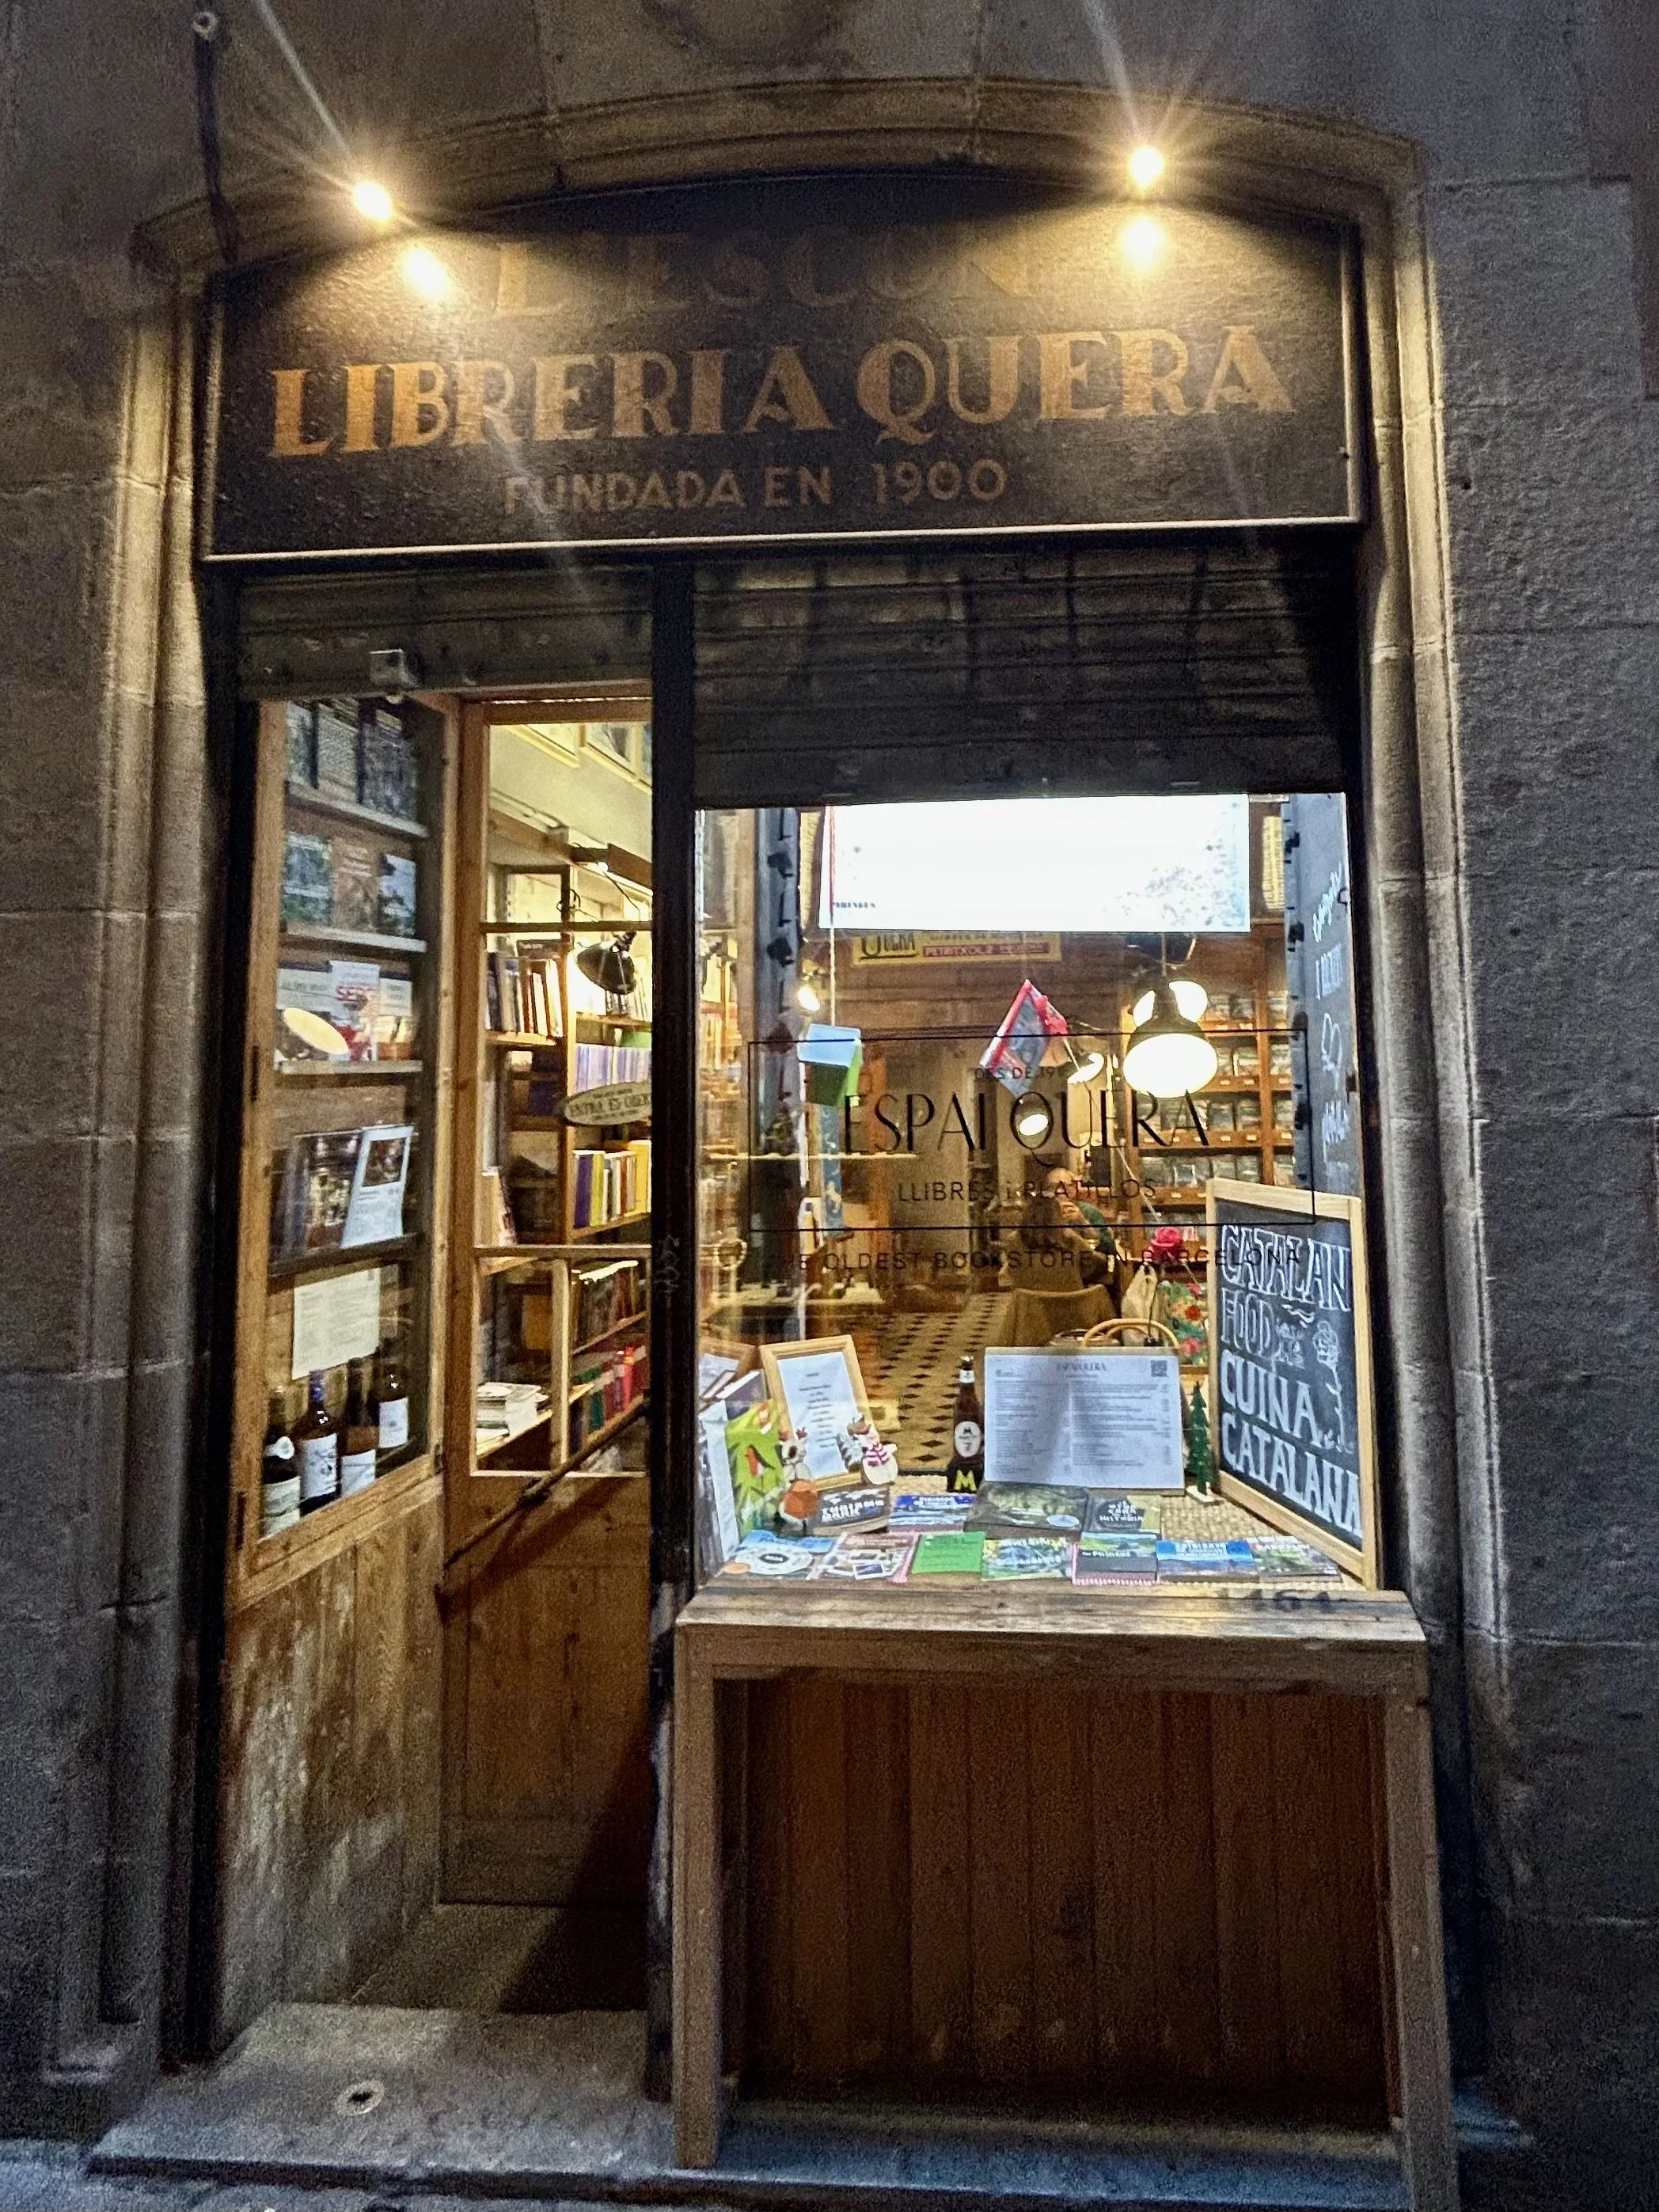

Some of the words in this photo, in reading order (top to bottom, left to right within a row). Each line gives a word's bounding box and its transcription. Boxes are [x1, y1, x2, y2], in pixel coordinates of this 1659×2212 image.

[268, 343, 841, 457] LIBRERIA
[856, 324, 1296, 445] QUERA
[504, 470, 746, 516] FUNDADA
[763, 466, 832, 507] EN
[872, 458, 1007, 506] 1900
[845, 1091, 986, 1155] ESPAI
[1010, 1089, 1209, 1167] QUERA
[898, 1181, 995, 1201] LLIBRES
[826, 1252, 921, 1270] OLDEST
[933, 1250, 1093, 1269] BOOKSTORE
[1221, 1224, 1351, 1312] CATALAN
[1221, 1349, 1322, 1447] CUINA
[1221, 1412, 1363, 1539] CATALANA
